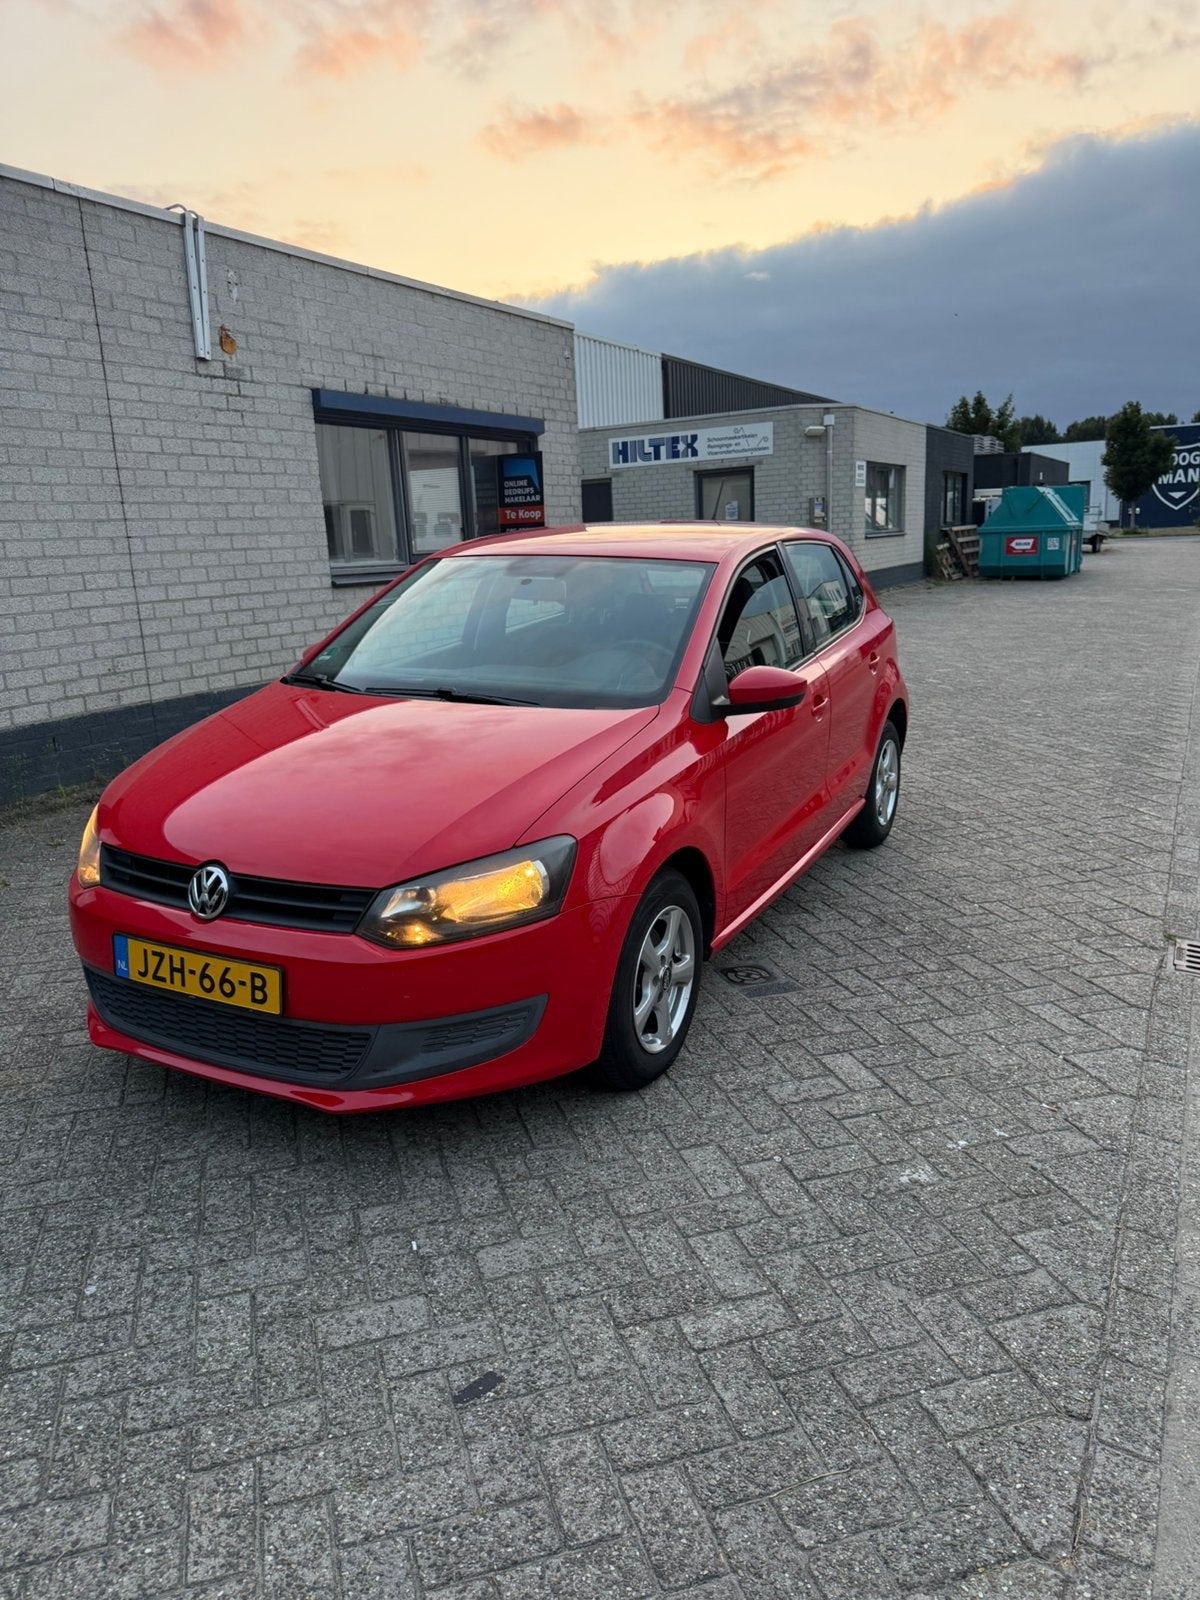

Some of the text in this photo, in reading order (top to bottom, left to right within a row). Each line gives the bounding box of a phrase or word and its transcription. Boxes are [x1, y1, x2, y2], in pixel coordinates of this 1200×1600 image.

[612, 434, 698, 464] HILTEX
[1158, 468, 1199, 484] MAN
[504, 480, 528, 488] ONLINE
[504, 487, 535, 496] BEDRIJFS
[504, 495, 541, 503] MAKELAAR
[504, 509, 541, 520] Te Koop
[117, 959, 128, 971] NL
[137, 948, 268, 1005] JZH-66-B
